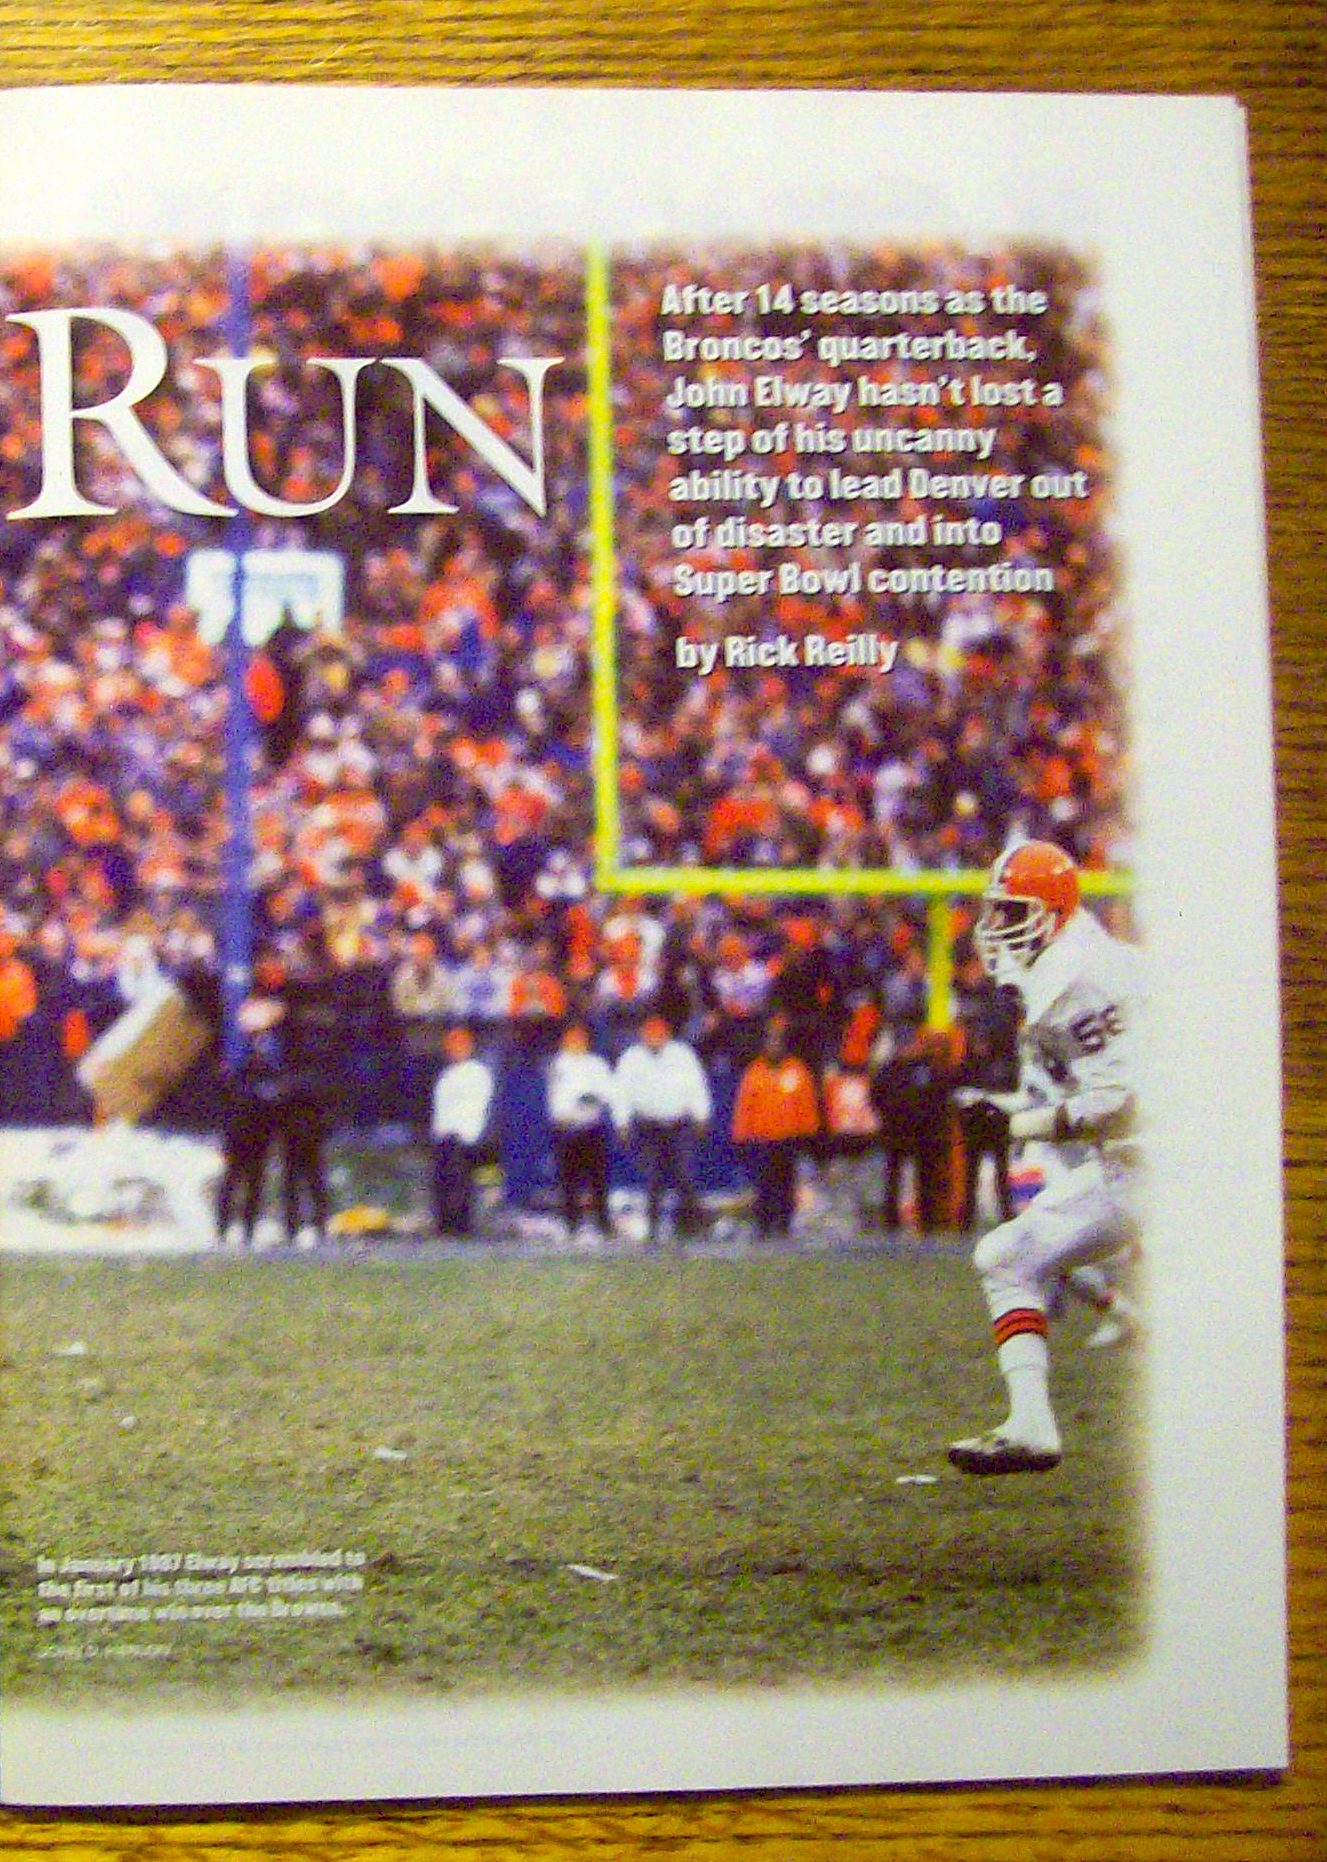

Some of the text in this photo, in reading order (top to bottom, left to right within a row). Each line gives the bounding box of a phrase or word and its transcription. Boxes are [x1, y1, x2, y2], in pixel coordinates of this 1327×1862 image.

[661, 283, 1049, 315] After 14 seasons as the
[662, 328, 1038, 368] Broncos’ quarterback,
[6, 307, 565, 519] RUN
[665, 374, 1065, 414] John Elway hasn’t lost a
[666, 421, 997, 462] step of his uncanny
[668, 468, 1089, 508] ability to lead Denver out
[672, 514, 1003, 548] of disaster and into
[673, 561, 1056, 604] Super Bowl contention
[675, 633, 899, 675] by Rick Reilly
